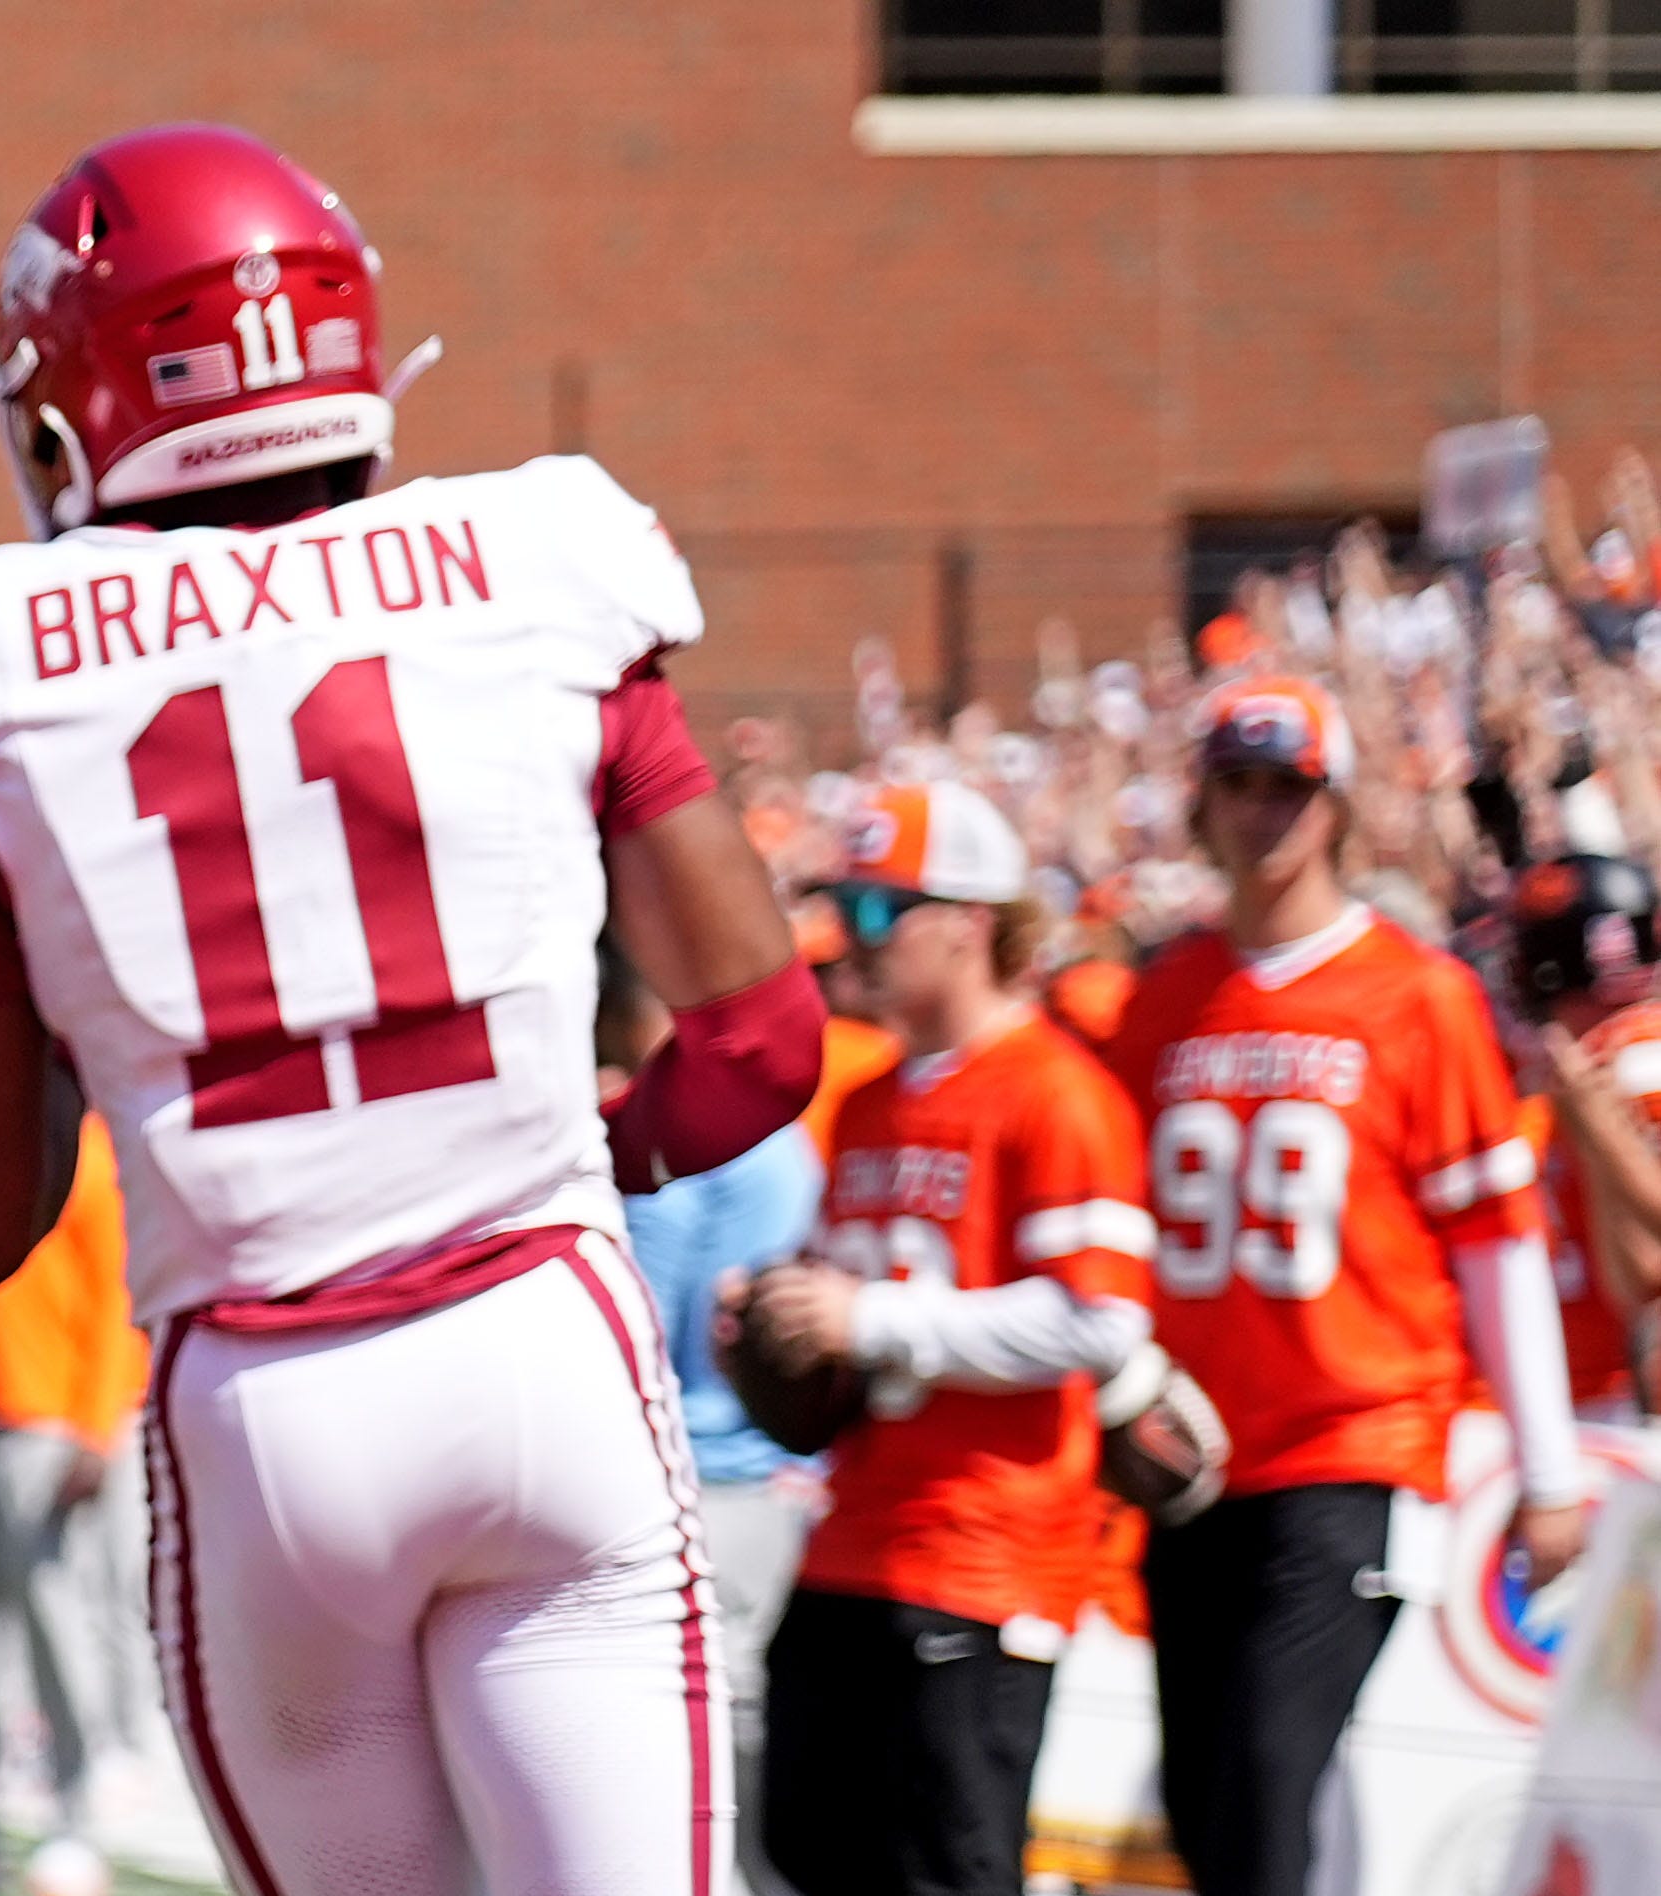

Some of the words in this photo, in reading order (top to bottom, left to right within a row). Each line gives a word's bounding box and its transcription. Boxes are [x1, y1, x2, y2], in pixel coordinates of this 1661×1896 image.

[231, 293, 306, 392] 11
[28, 519, 491, 680] BRAXTON
[125, 654, 497, 1129] 11
[1149, 1098, 1356, 1301] 99
